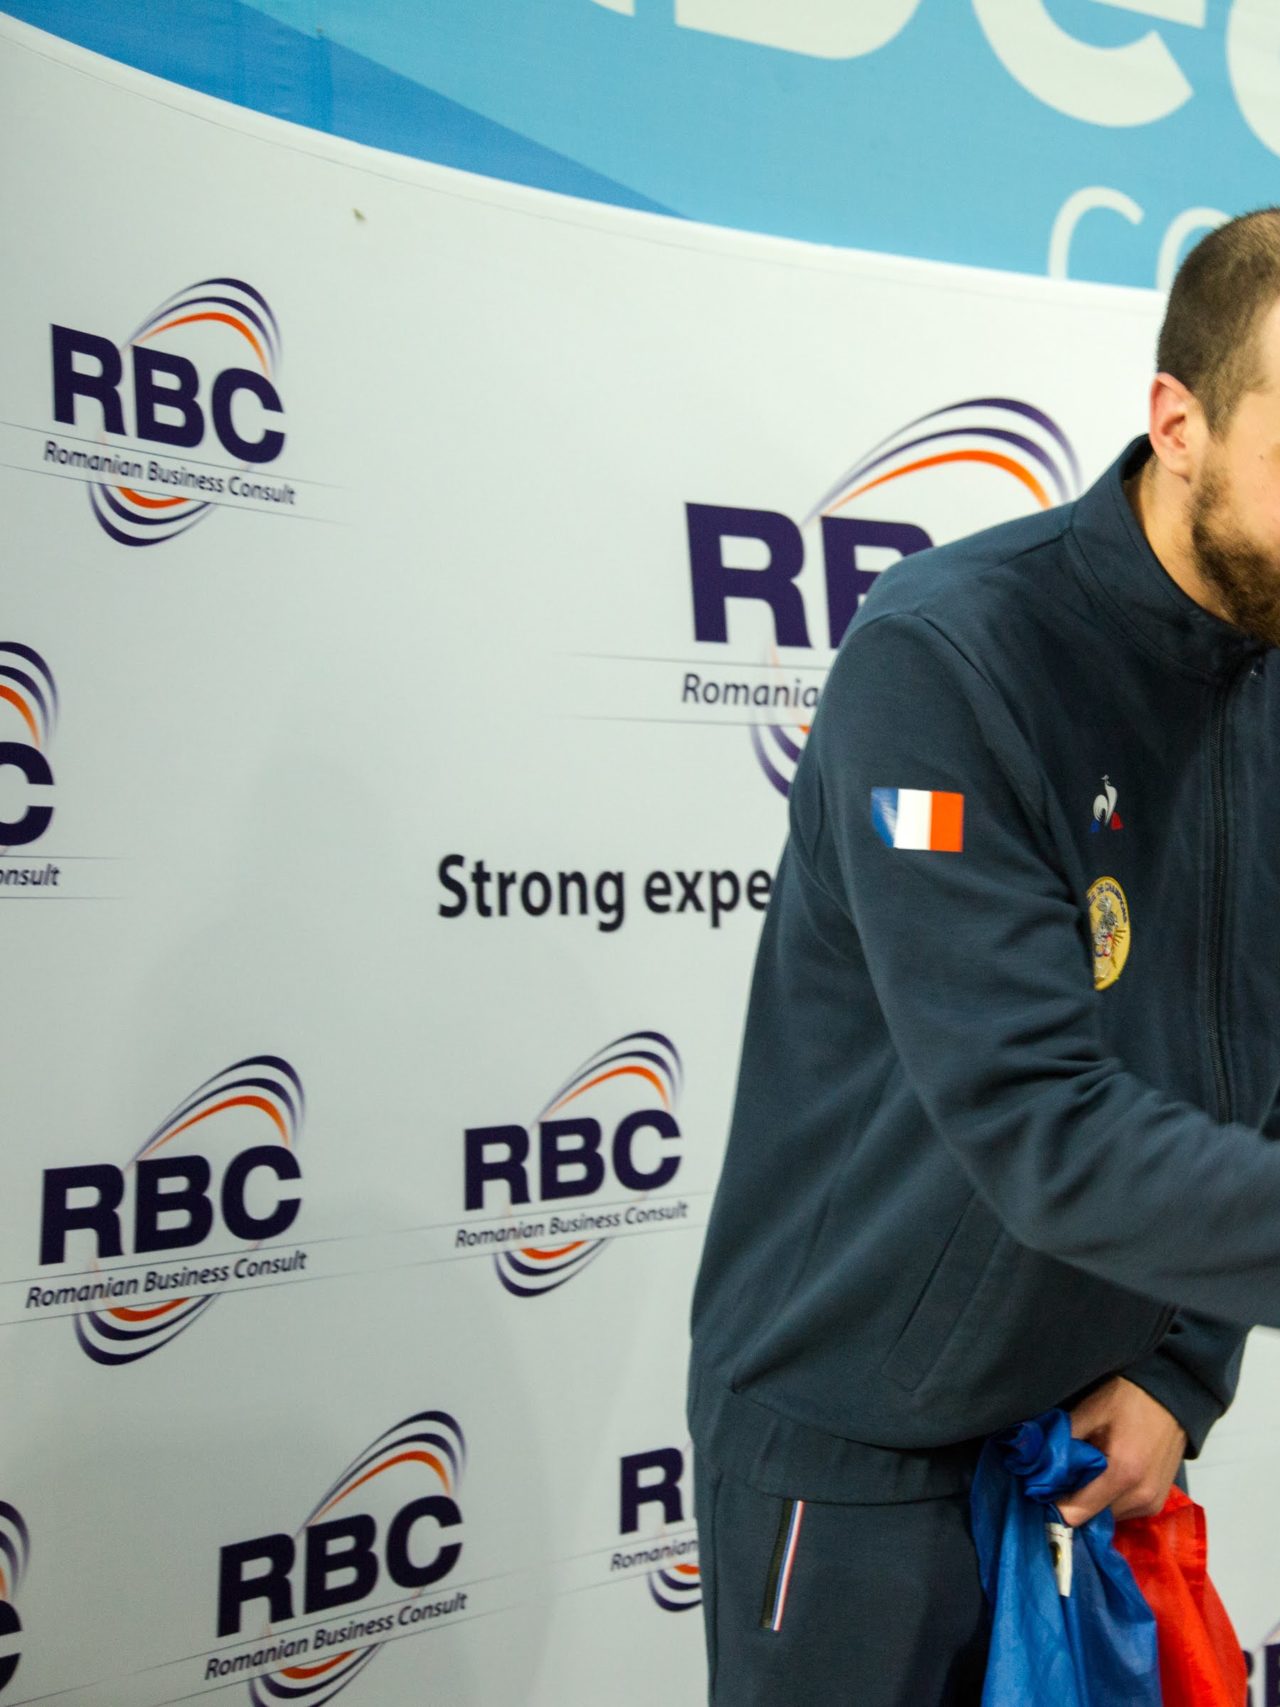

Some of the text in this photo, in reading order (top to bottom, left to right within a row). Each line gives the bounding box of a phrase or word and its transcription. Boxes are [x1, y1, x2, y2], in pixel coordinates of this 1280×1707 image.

[50, 323, 286, 464] RBC
[43, 440, 297, 505] Romanian Business Consult
[685, 502, 936, 649] RB
[682, 672, 819, 708] Romania
[0, 863, 60, 886] nsult
[437, 853, 776, 933] Strong expe
[464, 1109, 682, 1212] RBC
[39, 1145, 303, 1266] RBC
[454, 1201, 690, 1249] Romanian Business Consult
[25, 1250, 309, 1309] Romanian Business Consult
[216, 1494, 464, 1638] RBC
[204, 1592, 469, 1681] Romanian Business Consult
